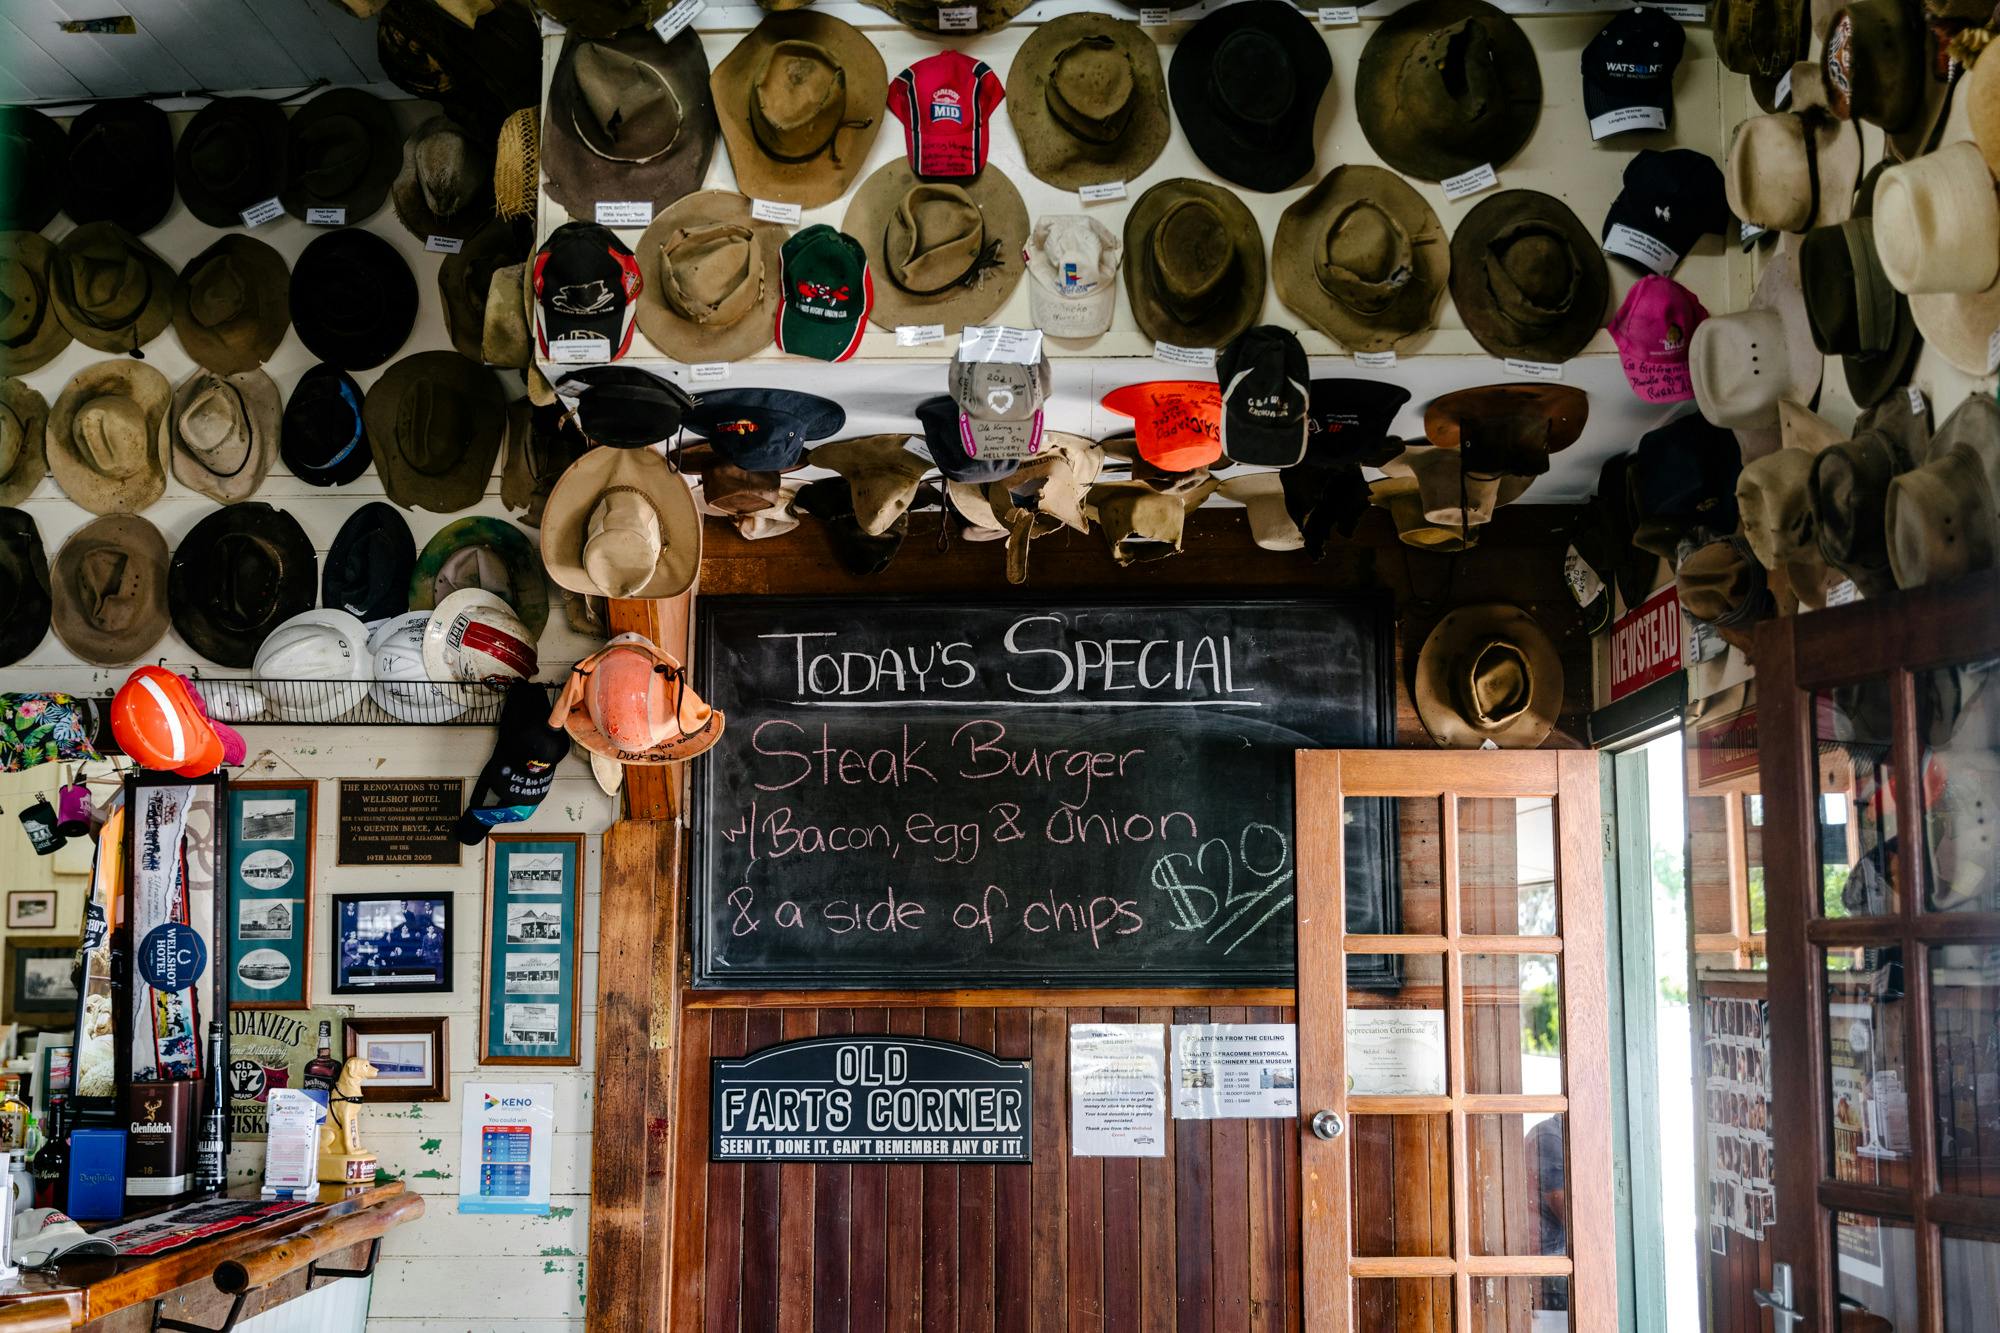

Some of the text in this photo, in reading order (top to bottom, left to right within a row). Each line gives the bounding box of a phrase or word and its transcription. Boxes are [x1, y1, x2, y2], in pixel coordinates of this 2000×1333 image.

[932, 88, 960, 100] CARLTON
[934, 104, 960, 118] MID
[987, 374, 1012, 383] 2021
[1611, 600, 1678, 687] NEWSTEAD
[757, 616, 1255, 696] TODAY'S SPECIAL
[616, 750, 643, 761] DUCK
[751, 718, 1145, 806] Steak Burger
[343, 783, 461, 792] THE RENOVATIONS TO THE
[362, 795, 441, 803] WELLSHOT HOTEL
[402, 825, 430, 834] BRYCE,
[906, 811, 980, 864] egg
[989, 802, 1026, 841] &
[1046, 803, 1198, 846] onion
[1151, 821, 1289, 933] $20
[727, 885, 1143, 949] & a side of chips
[87, 919, 107, 934] HOT
[156, 939, 166, 976] HOTEL
[166, 927, 177, 987] WELLSHOT
[235, 1011, 307, 1048] DANIEL'S
[1390, 1026, 1425, 1034] Certificate
[836, 1045, 908, 1086] OLD
[502, 1098, 532, 1107] KENO
[721, 1088, 1022, 1133] FARTS CORNER
[131, 1122, 172, 1134] Glenfiddich
[720, 1140, 1021, 1156] SEEN IT, DONE IT, CAN'T REMEMBER ANY OF IT!
[40, 1169, 60, 1179] Maria
[143, 1166, 153, 1175] 18
